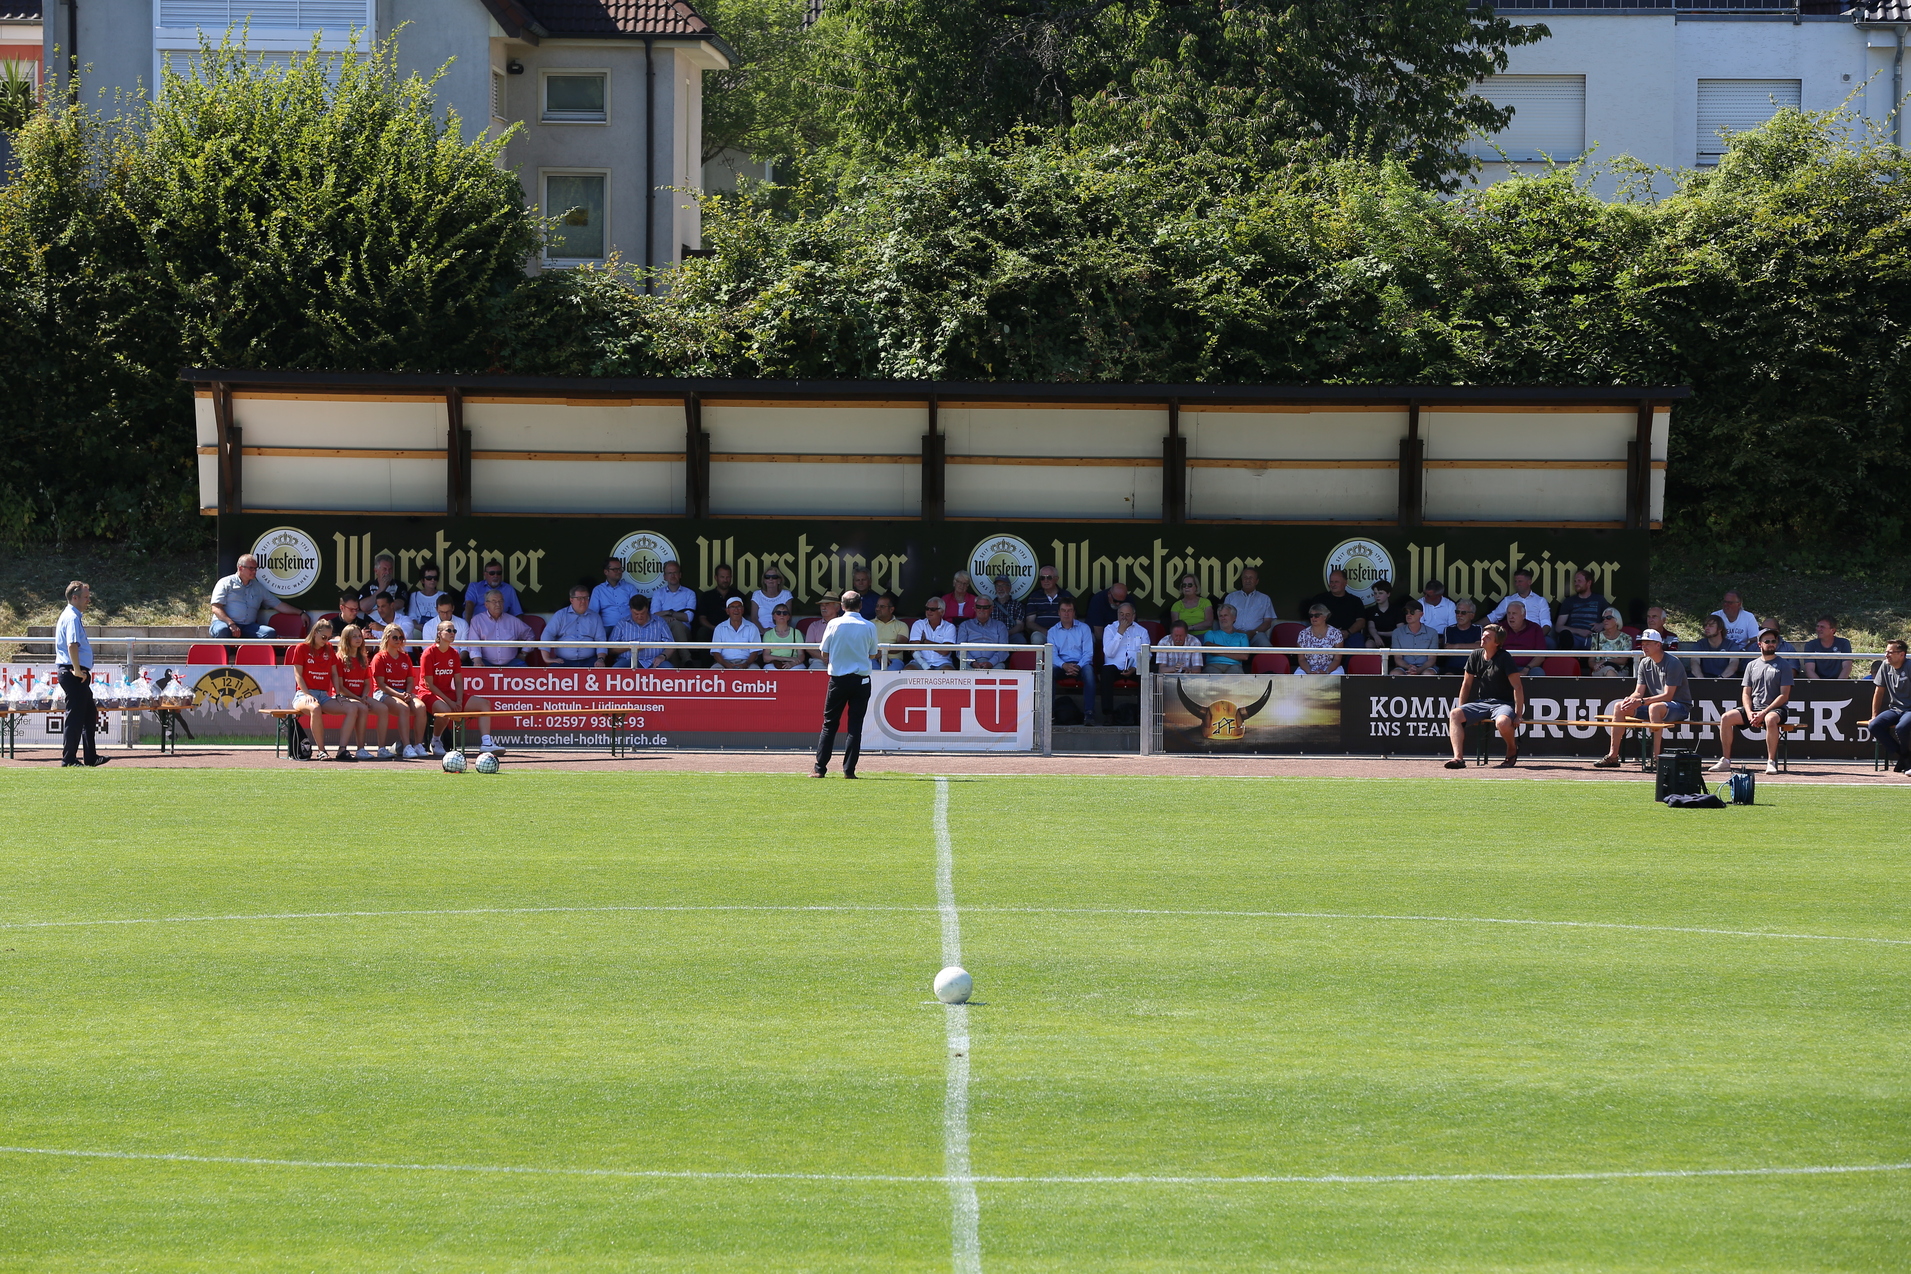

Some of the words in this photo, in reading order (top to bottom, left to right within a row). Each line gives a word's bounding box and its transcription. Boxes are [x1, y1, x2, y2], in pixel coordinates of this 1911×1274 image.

[261, 541, 271, 552] SEIT
[620, 545, 630, 556] SEIT
[659, 545, 669, 556] 1753
[980, 548, 989, 559] SEIT
[1335, 552, 1345, 563] SEIT
[256, 552, 316, 572] Warsteiner
[974, 559, 1033, 577] Warsteiner
[261, 574, 271, 584] DAS
[271, 582, 291, 590] EINZIG
[293, 574, 309, 588] WAHRE
[652, 580, 667, 591] WAHR
[979, 581, 989, 591] DAS
[489, 673, 578, 692] Troschel
[585, 674, 600, 692] &
[606, 674, 726, 693] Holthenrich
[732, 680, 777, 693] GmbH
[908, 678, 972, 686] VERTRAGSPARTNER
[494, 702, 533, 711] Senden
[543, 702, 582, 711] Nottuln
[884, 679, 1018, 733] GTÜ
[514, 716, 542, 728] Tel.:
[546, 716, 587, 728] 02597
[1370, 722, 1401, 736] INS
